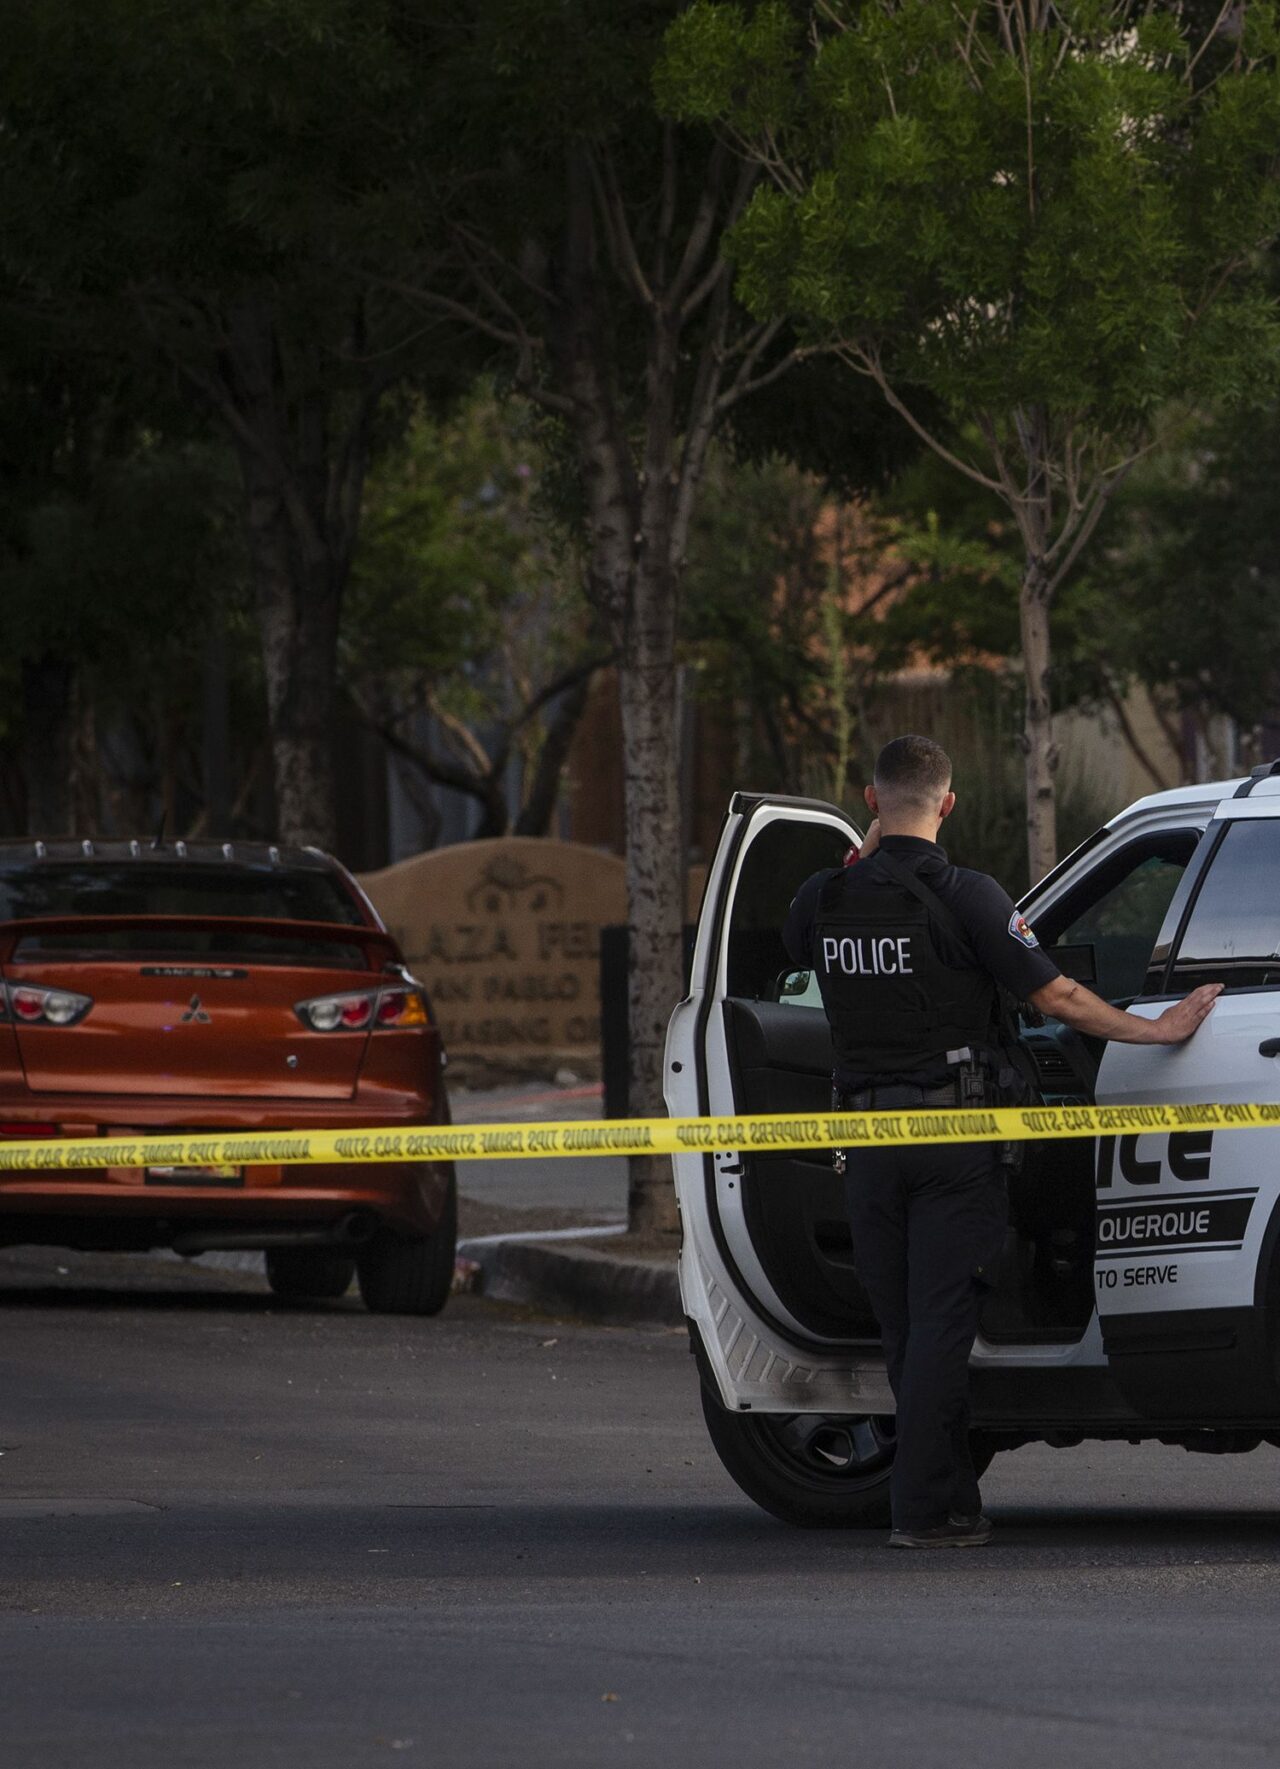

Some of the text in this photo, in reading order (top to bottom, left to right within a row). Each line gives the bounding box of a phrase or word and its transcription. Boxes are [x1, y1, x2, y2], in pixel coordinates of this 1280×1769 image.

[823, 938, 913, 975] POLICE
[1099, 1210, 1210, 1241] QUERQUE
[1096, 1265, 1178, 1289] TO SERVE
